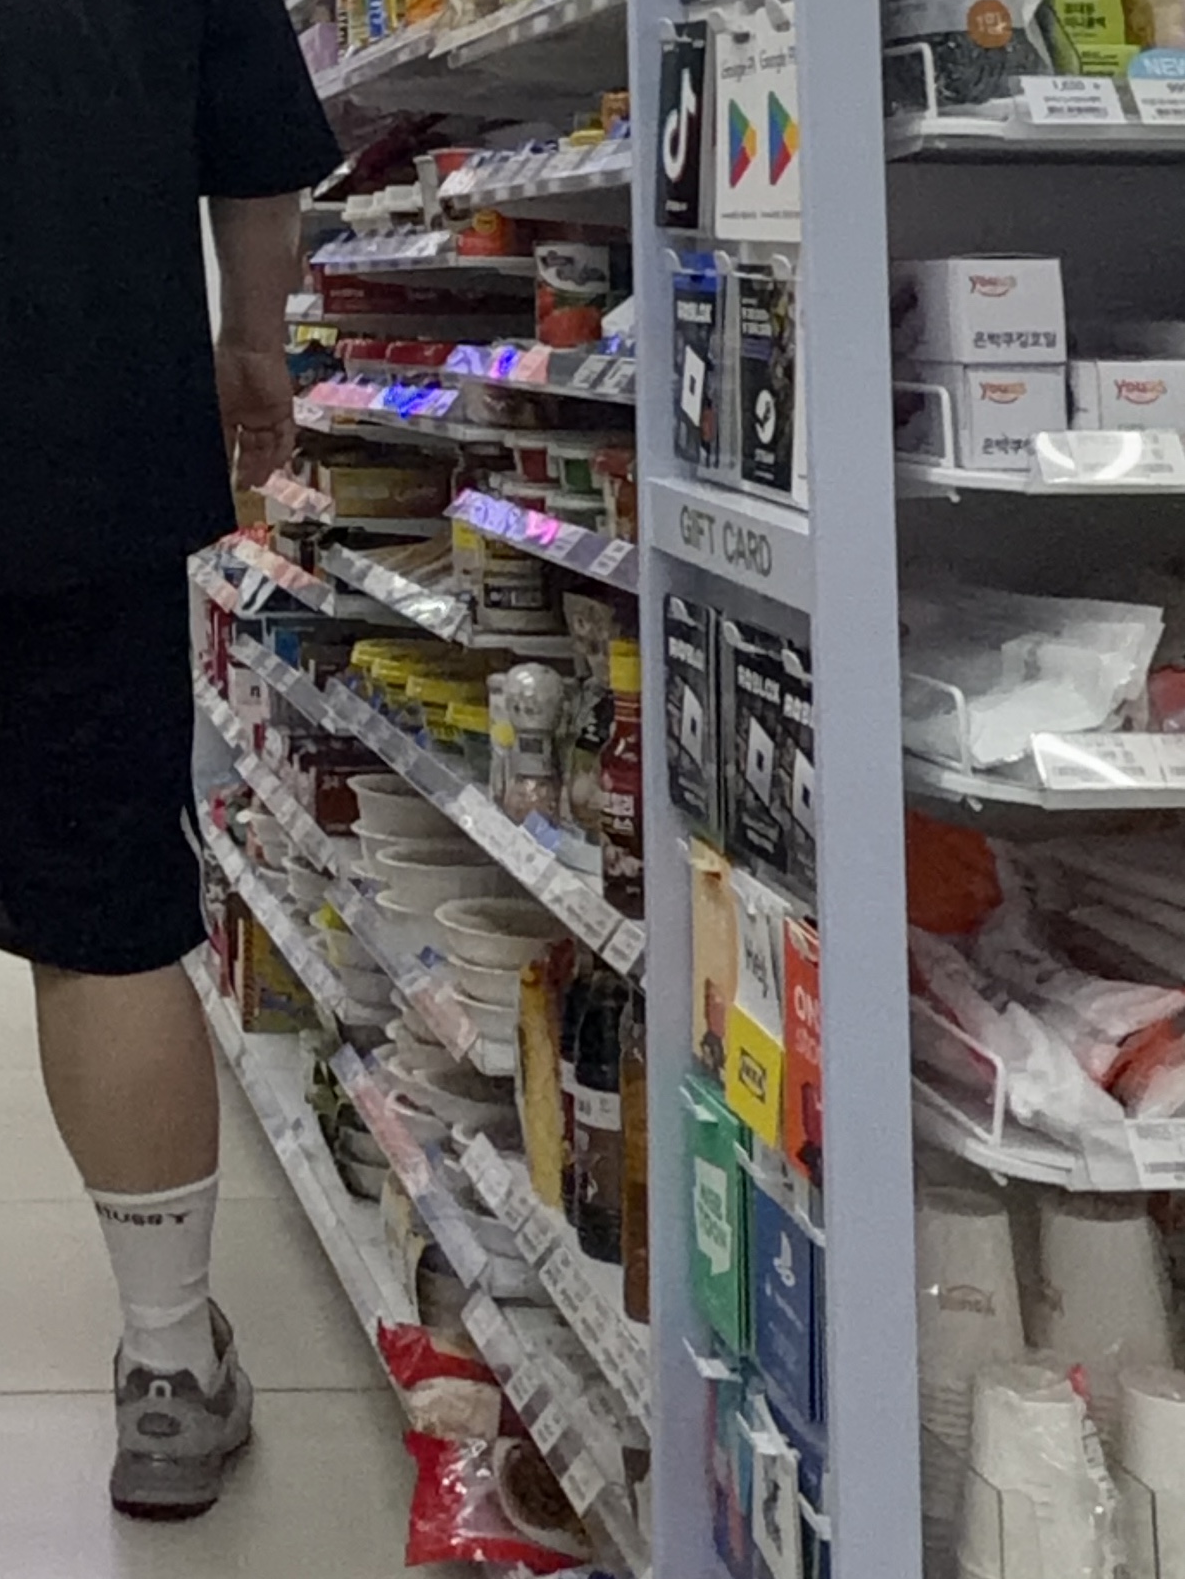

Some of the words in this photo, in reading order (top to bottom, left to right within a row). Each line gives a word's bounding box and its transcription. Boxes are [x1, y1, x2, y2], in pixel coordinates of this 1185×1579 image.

[972, 330, 1057, 350] 은박쿠킹호일
[679, 504, 716, 556] GIFT
[722, 520, 773, 578] CARD
